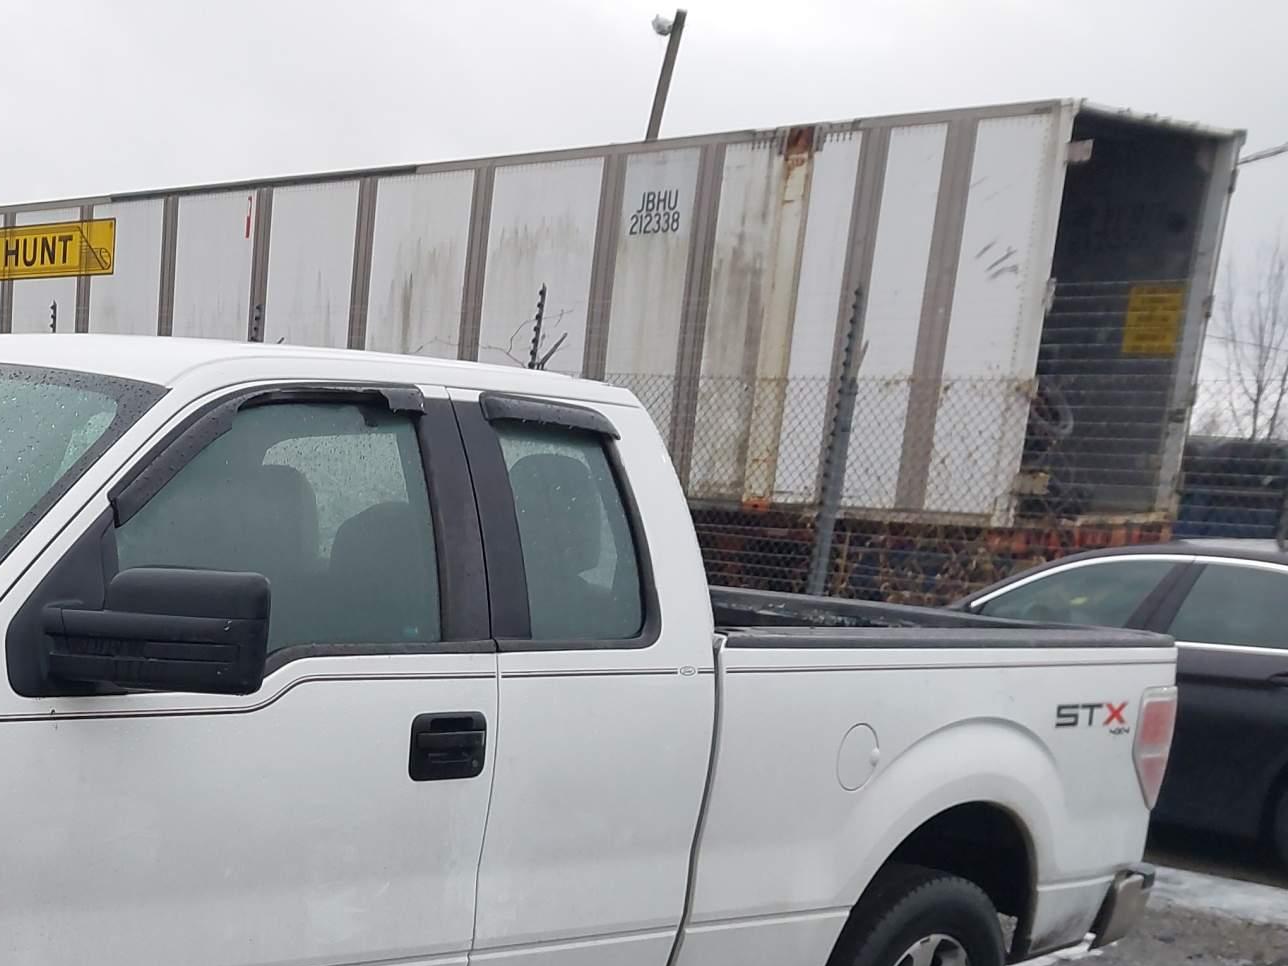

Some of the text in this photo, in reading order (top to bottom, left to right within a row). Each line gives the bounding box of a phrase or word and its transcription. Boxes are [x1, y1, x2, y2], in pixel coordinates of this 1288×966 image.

[636, 189, 679, 213] JBHU
[629, 211, 680, 235] 212338
[5, 235, 73, 268] HUNT
[1055, 701, 1129, 728] STX
